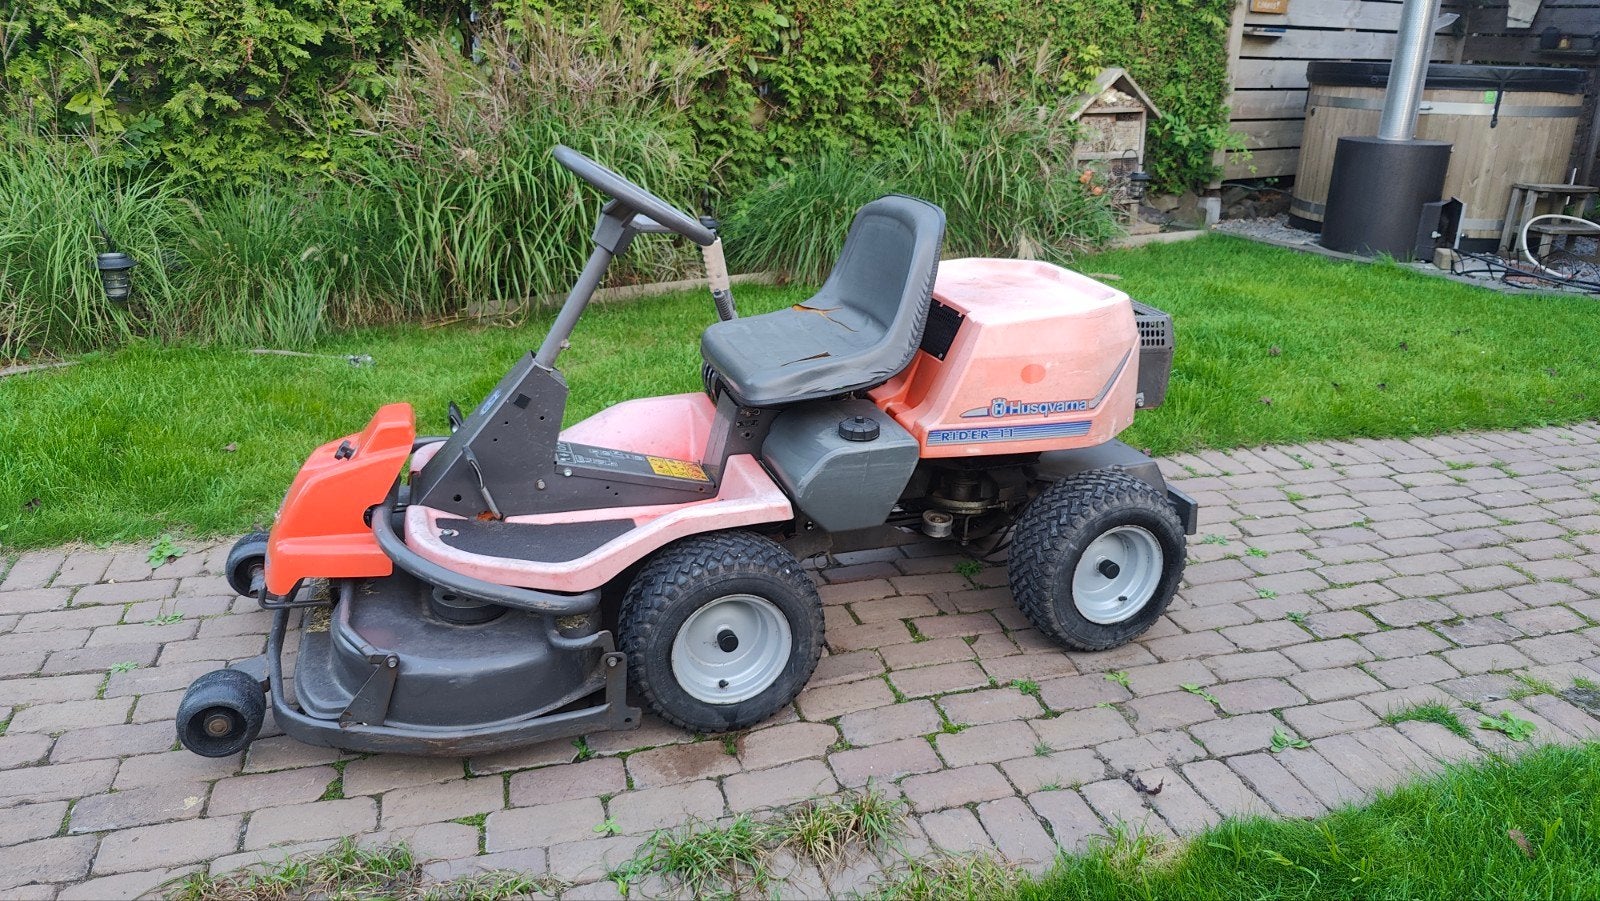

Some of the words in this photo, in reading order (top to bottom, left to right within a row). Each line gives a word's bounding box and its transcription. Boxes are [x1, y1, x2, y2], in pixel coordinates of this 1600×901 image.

[1009, 400, 1087, 417] Husqvarna
[942, 430, 989, 441] RIDER
[1000, 429, 1013, 438] 11
